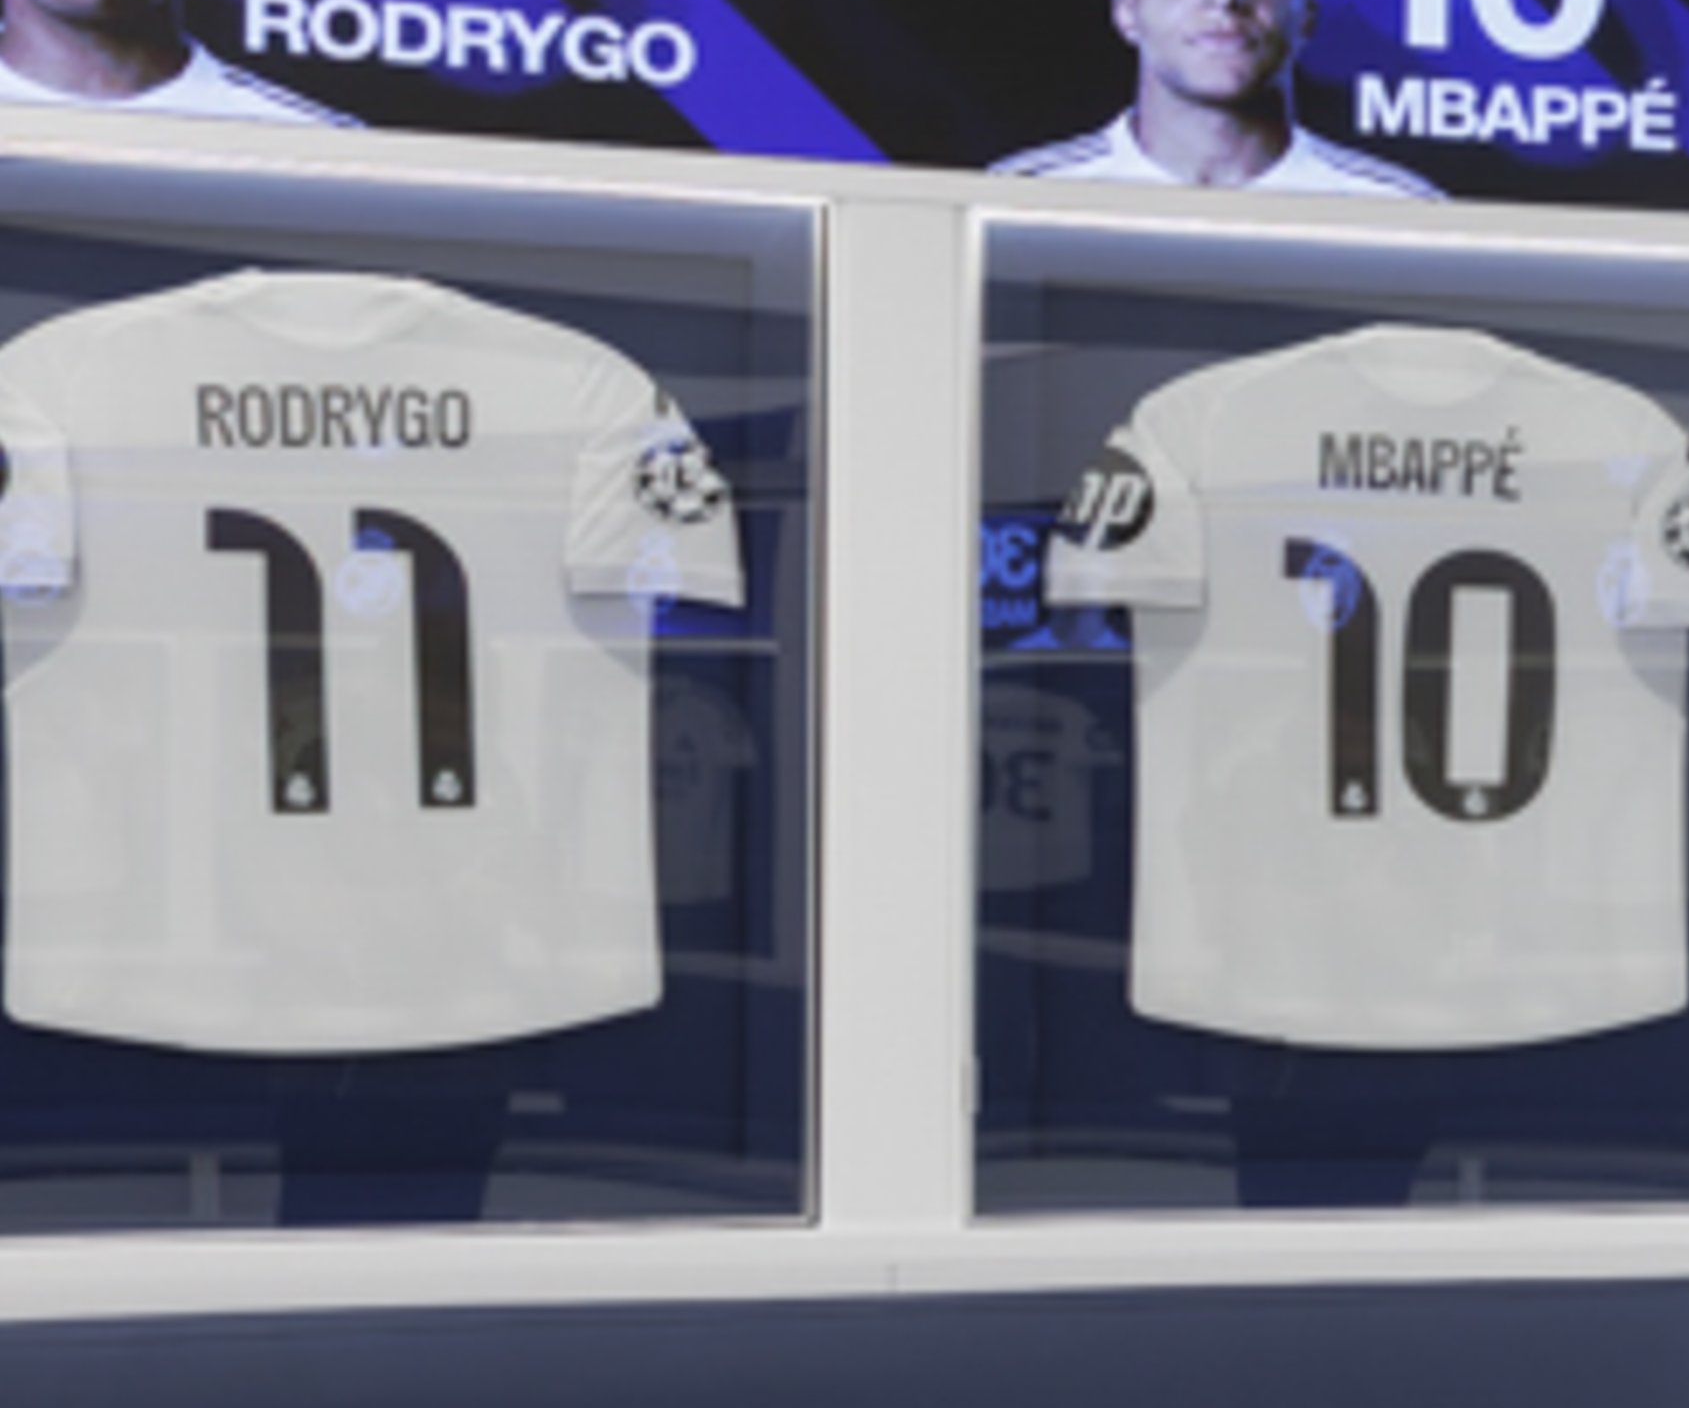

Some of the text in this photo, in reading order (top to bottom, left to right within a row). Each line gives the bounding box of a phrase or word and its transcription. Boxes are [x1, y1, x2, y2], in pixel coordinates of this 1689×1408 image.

[1356, 73, 1680, 152] MBAPPÉ
[196, 383, 472, 449] RODRYGO
[1318, 428, 1524, 501] MBAPPÉ
[205, 506, 477, 814] 11
[1283, 537, 1558, 823] 10
